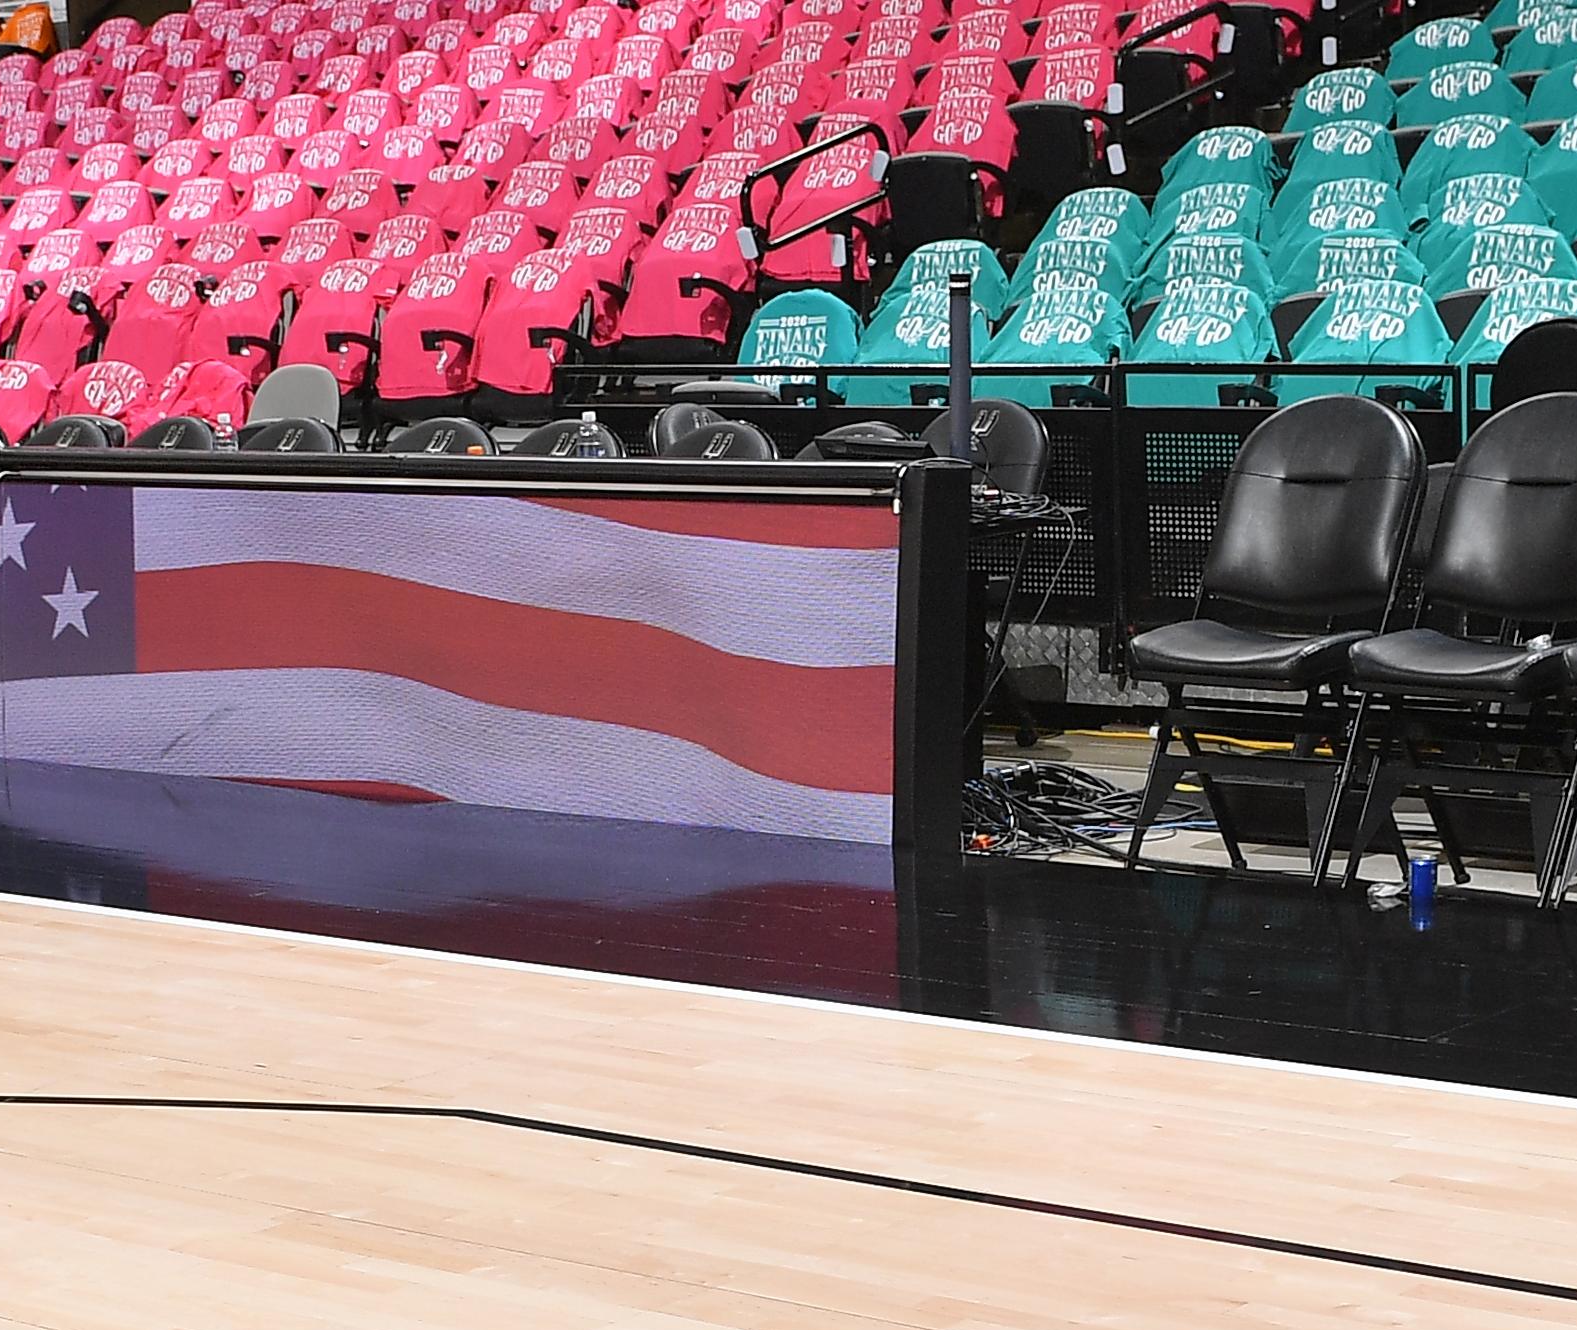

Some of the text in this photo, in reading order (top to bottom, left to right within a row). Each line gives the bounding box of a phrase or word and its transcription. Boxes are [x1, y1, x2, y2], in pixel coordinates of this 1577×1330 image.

[1046, 11, 1099, 33] FINALS
[1535, 20, 1561, 45] GO
[867, 37, 911, 57] GO GO
[1045, 33, 1064, 50] GO
[941, 64, 995, 90] FINALS
[1044, 56, 1100, 86] FINALS
[1467, 70, 1492, 96] GO
[752, 84, 798, 106] GO GO
[1045, 79, 1095, 101] GO GO
[1305, 86, 1365, 112] GO GO
[935, 97, 993, 125] FINALS
[933, 121, 982, 145] GO GO
[1434, 124, 1458, 148] GO
[810, 148, 871, 175] FINALS
[595, 179, 641, 199] GO GO
[804, 167, 857, 189] GO GO
[1445, 176, 1520, 205] FINALS
[1058, 189, 1128, 217] FINALS
[1180, 185, 1247, 212] FINALS
[1310, 179, 1389, 205] FINALS
[668, 208, 732, 237] FINALS
[191, 243, 235, 263] GO GO
[281, 242, 327, 264] GO GO
[463, 233, 511, 257] GO GO
[663, 230, 717, 252] GO GO
[1468, 232, 1554, 273] FINALS
[1033, 241, 1108, 277] FINALS
[1165, 246, 1244, 281] FINALS
[320, 269, 368, 292] GO GO
[210, 281, 257, 307] GO GO
[1161, 286, 1248, 322] FINALS
[1333, 281, 1424, 317] FINALS
[1024, 290, 1107, 325] FINALS
[1019, 320, 1051, 346] GO
[1156, 317, 1232, 345] GO GO
[1327, 314, 1405, 341] GO GO
[755, 326, 827, 362] FINALS
